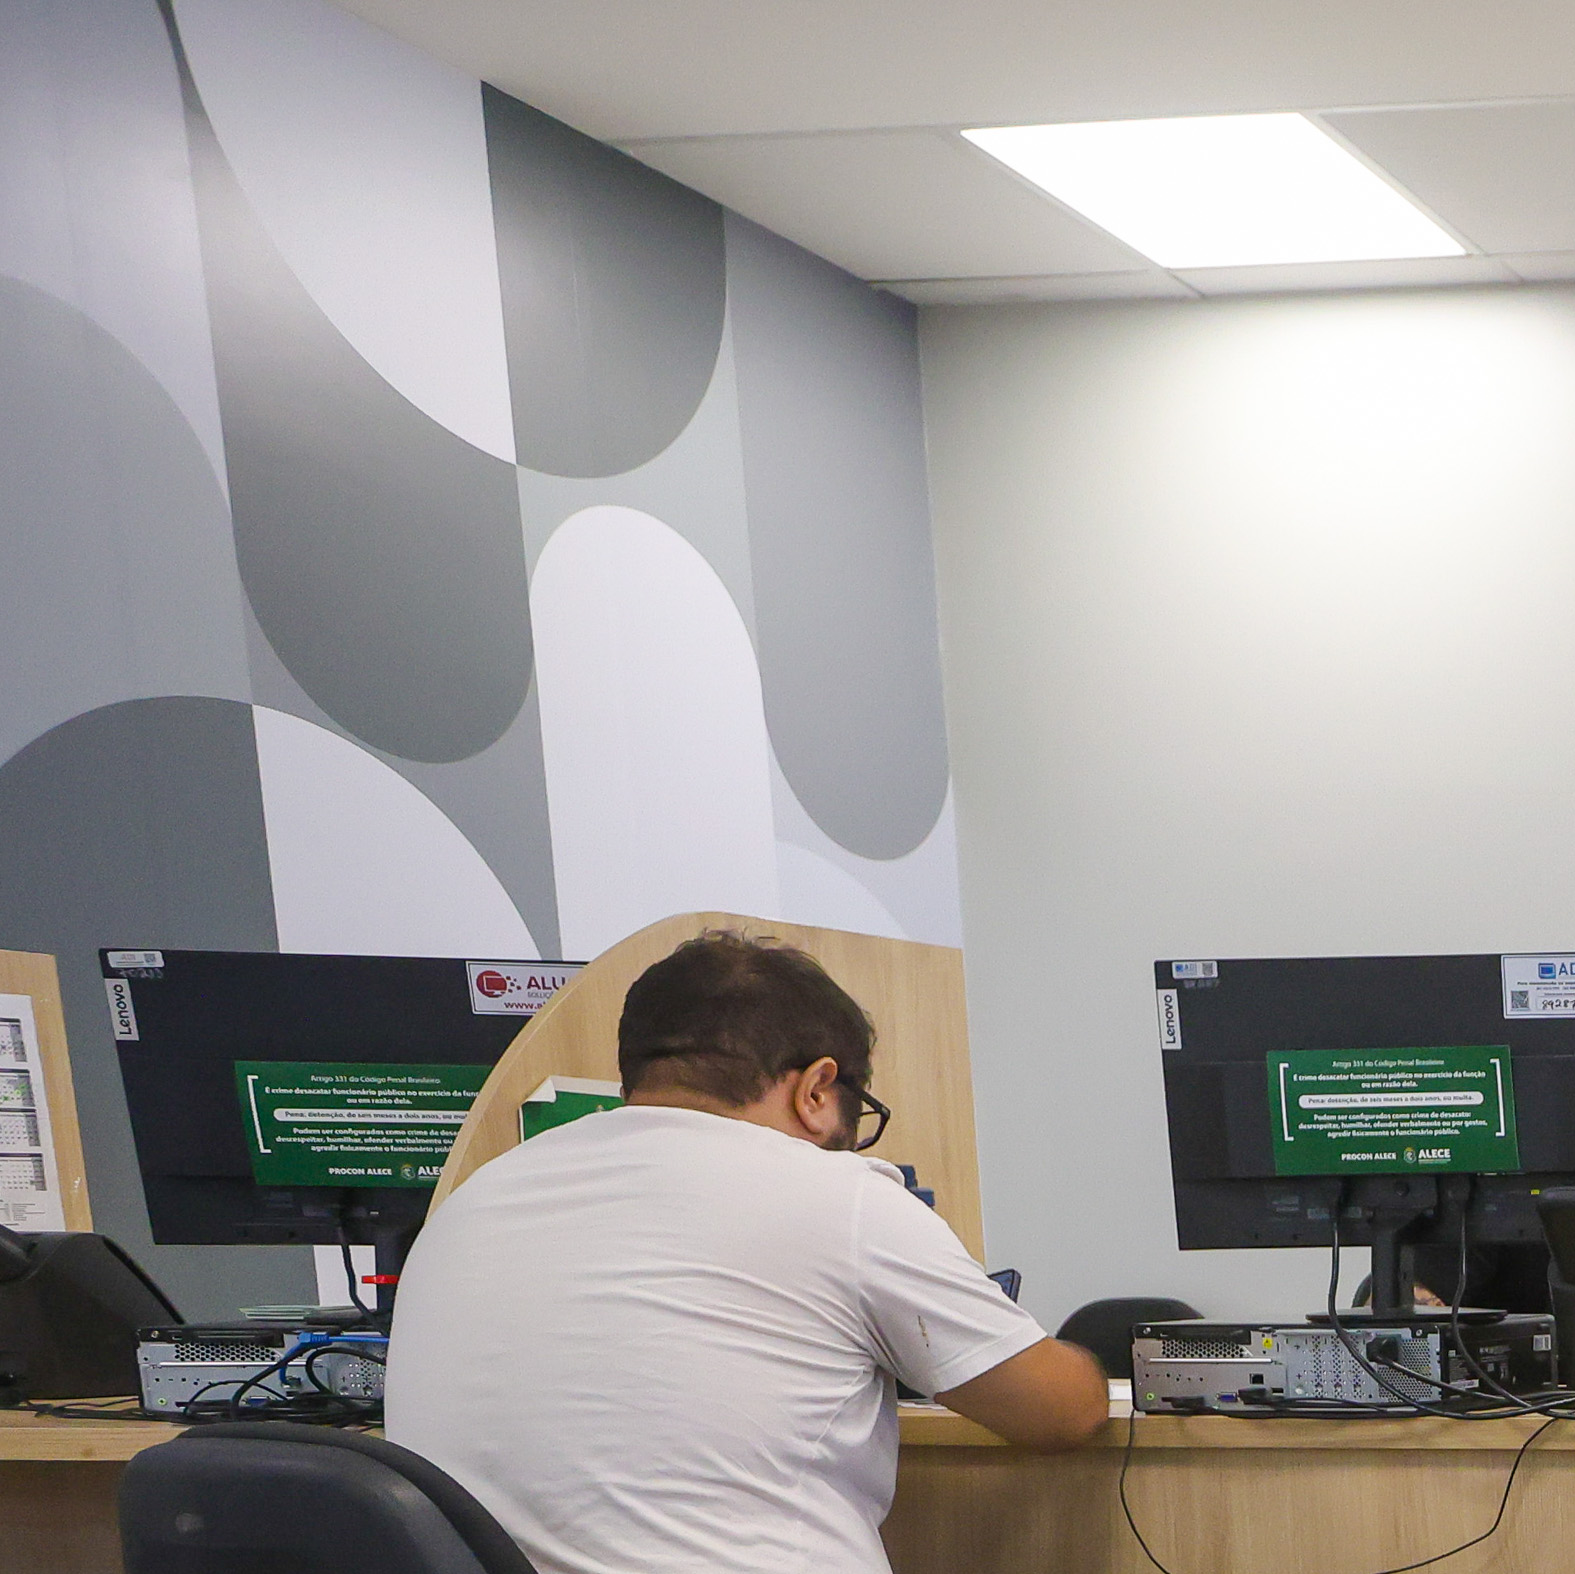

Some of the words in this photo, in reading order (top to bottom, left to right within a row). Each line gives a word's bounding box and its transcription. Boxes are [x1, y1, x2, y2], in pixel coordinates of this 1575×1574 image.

[527, 976, 566, 990] ALU
[114, 984, 132, 1035] Lenovo
[1164, 994, 1176, 1044] Lenovo
[1341, 1152, 1373, 1161] PROCON
[1374, 1151, 1397, 1160] ALECE
[1417, 1148, 1451, 1159] ALECE
[327, 1167, 365, 1176] PROCON
[365, 1167, 392, 1176] ALECE
[417, 1165, 446, 1175] ALE
